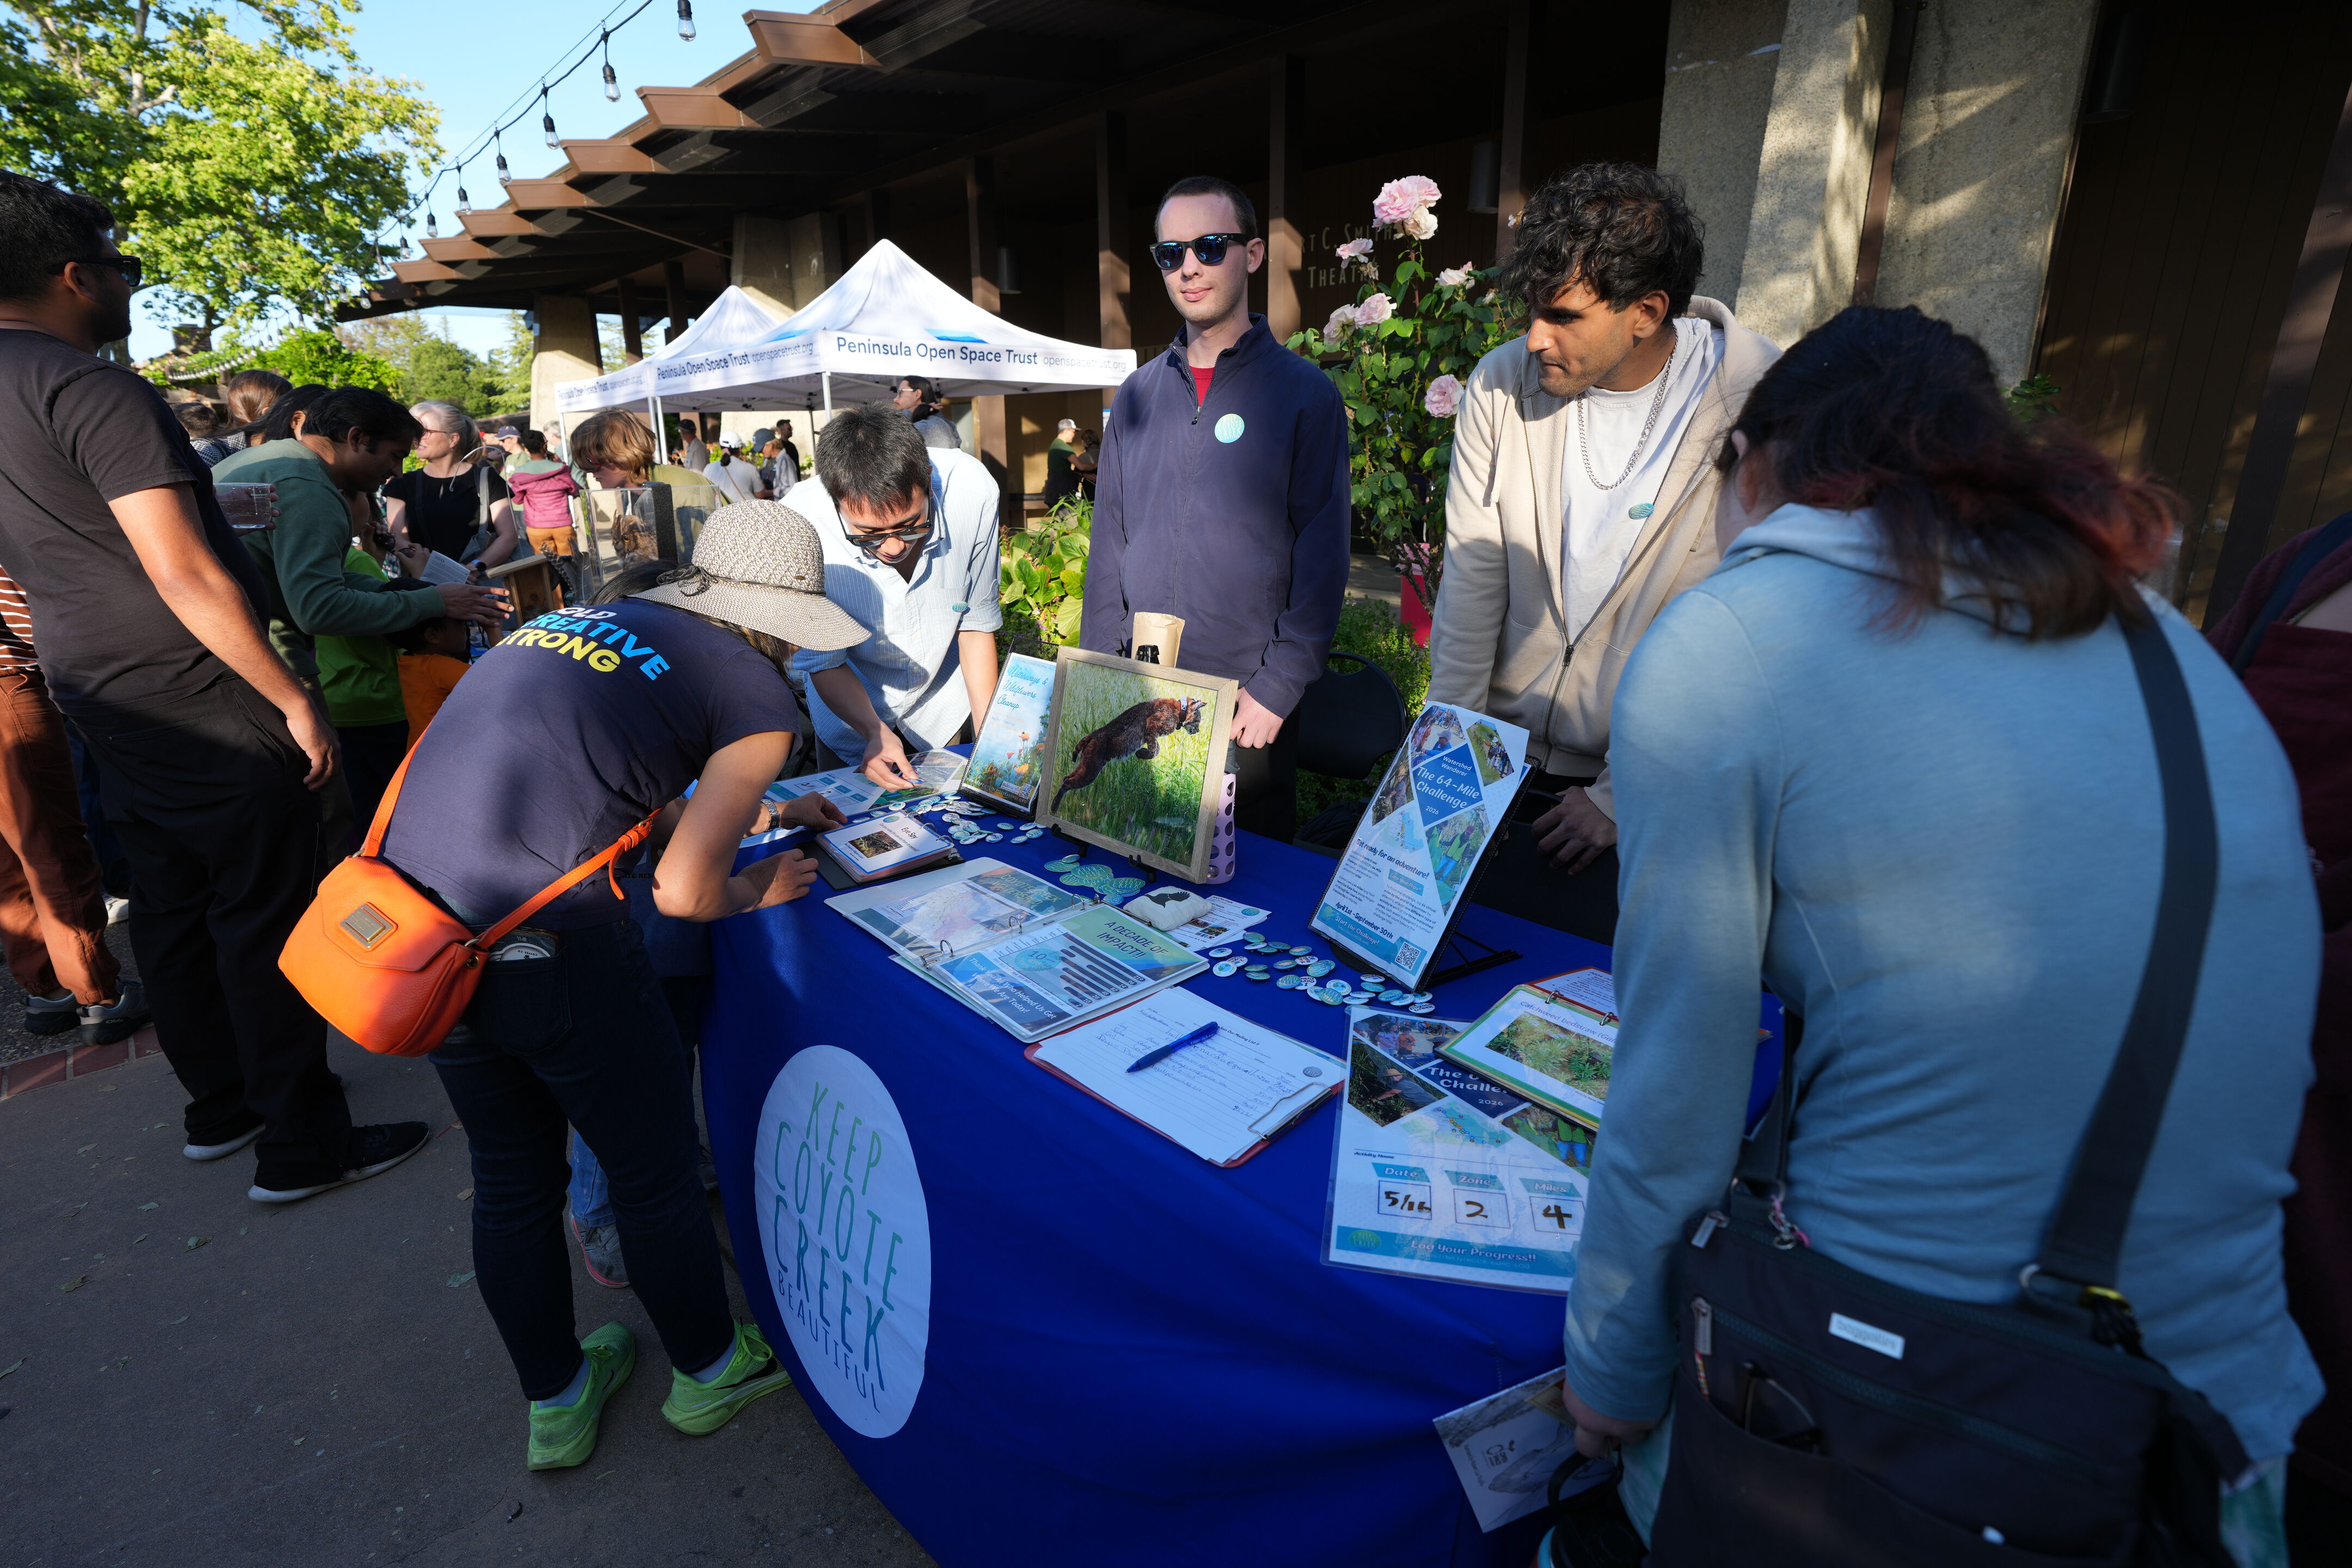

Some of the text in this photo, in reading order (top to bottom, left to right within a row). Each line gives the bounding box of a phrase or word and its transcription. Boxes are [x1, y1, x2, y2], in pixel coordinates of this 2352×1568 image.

[1308, 265, 1368, 289] THEAT
[657, 342, 814, 380] Peninsula Open Space Trust openspacetrust.org
[837, 336, 1127, 372] Peninsula Open Space Trust openspacetrust.org
[596, 381, 609, 391] Trust
[1219, 427, 1241, 438] CREEK
[547, 607, 617, 619] OLD
[495, 628, 621, 672] STRONG
[1008, 666, 1049, 686] Waterways &
[1002, 679, 1037, 699] Wildflowers
[997, 694, 1019, 710] Cleanup
[1417, 766, 1435, 781] The
[1441, 762, 1468, 776] Wanderer
[1443, 756, 1472, 771] Watershed
[1416, 781, 1467, 808] Challenge
[1425, 805, 1440, 815] 2026
[1356, 838, 1364, 847] Get
[1363, 844, 1379, 856] ready
[1378, 849, 1388, 859] for
[1395, 859, 1430, 879] adventure!
[992, 880, 1044, 905] WATERSHED
[1000, 874, 1037, 891] COYOTE
[1389, 873, 1422, 892] Earn Your Prize!
[1335, 902, 1346, 911] April
[1380, 927, 1394, 940] 30th
[1335, 915, 1348, 927] Start
[1347, 923, 1356, 932] the
[1356, 928, 1380, 946] Challenge!
[1096, 932, 1147, 959] IMPACT!!
[1112, 925, 1155, 948] DECADE
[1150, 945, 1169, 954] OF
[1027, 950, 1047, 960] 10
[969, 957, 987, 972] Thank
[985, 970, 996, 979] You
[995, 977, 1004, 985] All
[1003, 981, 1016, 993] Who
[1015, 989, 1038, 1007] Helped
[1036, 1003, 1044, 1012] Us
[1043, 1009, 1058, 1020] Get
[972, 972, 1031, 1014] Where We Are Today!
[1520, 1001, 1561, 1021] Catchweed
[1561, 1017, 1597, 1034] bedstraw
[1235, 1033, 1248, 1042] Mailing
[1428, 1067, 1462, 1079] The
[1440, 1079, 1507, 1094] Challe
[806, 1081, 882, 1196] KEEP
[1385, 1167, 1418, 1178] Date
[1458, 1175, 1491, 1186] Zone
[1534, 1182, 1567, 1193] Miles
[773, 1120, 904, 1312] COYOTE
[1465, 1200, 1489, 1219] 2
[1541, 1204, 1572, 1229] 4
[1411, 1240, 1537, 1263] Log Your Progress!!
[773, 1194, 886, 1392] CREEK
[776, 1269, 881, 1414] BEAUTIFUL
